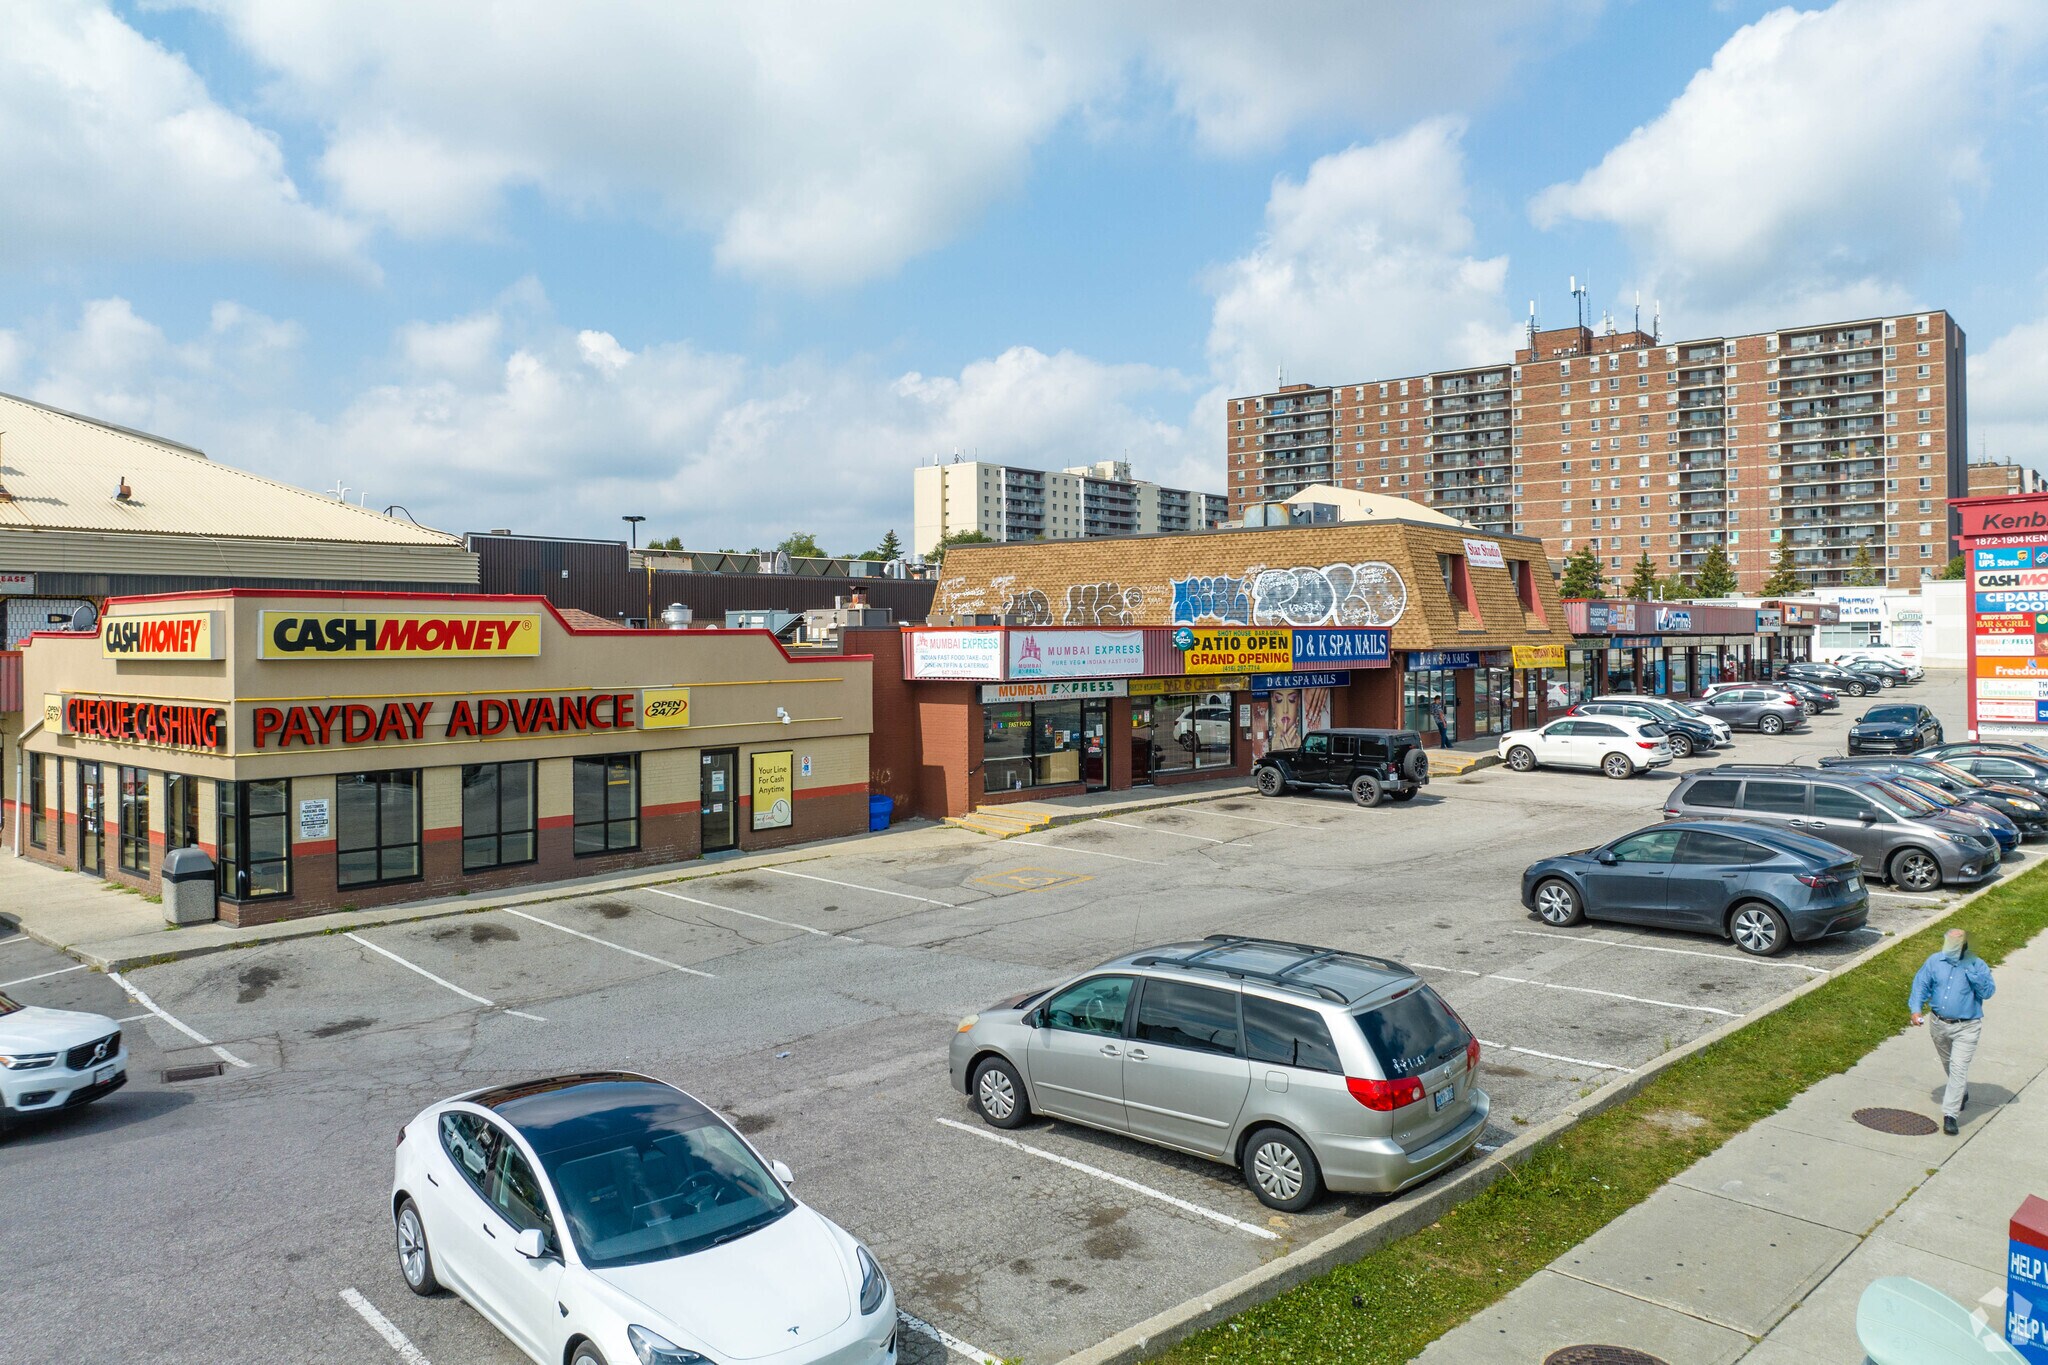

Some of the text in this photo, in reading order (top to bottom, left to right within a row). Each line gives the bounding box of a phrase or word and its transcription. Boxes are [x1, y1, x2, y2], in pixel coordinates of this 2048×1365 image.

[1982, 511, 2048, 530] Kenb
[1975, 536, 2024, 546] 1872-1904
[1467, 543, 1500, 557] Star Studio
[1978, 552, 1994, 560] The
[1997, 559, 2019, 567] Store
[1838, 596, 1874, 605] Pharmacy
[1590, 608, 1608, 616] PASSPORT
[1854, 607, 1879, 615] Centre
[929, 638, 999, 649] MUMBAI EXPRESS
[1190, 637, 1241, 651] PATIO
[1247, 636, 1288, 650] OPEN
[1295, 634, 1386, 657] D & K SPA NAILS
[1047, 645, 1141, 656] MUMBAI EXPRESS
[1190, 652, 1290, 665] GRAND OPENING
[1438, 653, 1451, 665] SPA
[1452, 653, 1470, 664] NAILS
[1995, 665, 2048, 676] Freedom
[1163, 680, 1182, 692] BAR
[1194, 678, 1216, 691] GRILL
[1267, 674, 1336, 687] D & K SPA NAILS
[998, 684, 1047, 697] MUMBAI
[1051, 681, 1114, 694] EXPRESS
[652, 700, 681, 708] OPEN
[651, 707, 679, 716] 24/7
[66, 698, 217, 748] CHEQUE CASHING
[253, 694, 635, 748] PAYDAY ADVANCE
[758, 766, 787, 775] Your Line
[758, 776, 785, 784] For Cash
[758, 785, 785, 795] Anytime
[2011, 1252, 2041, 1280] HELP
[2008, 1311, 2040, 1340] HELP
